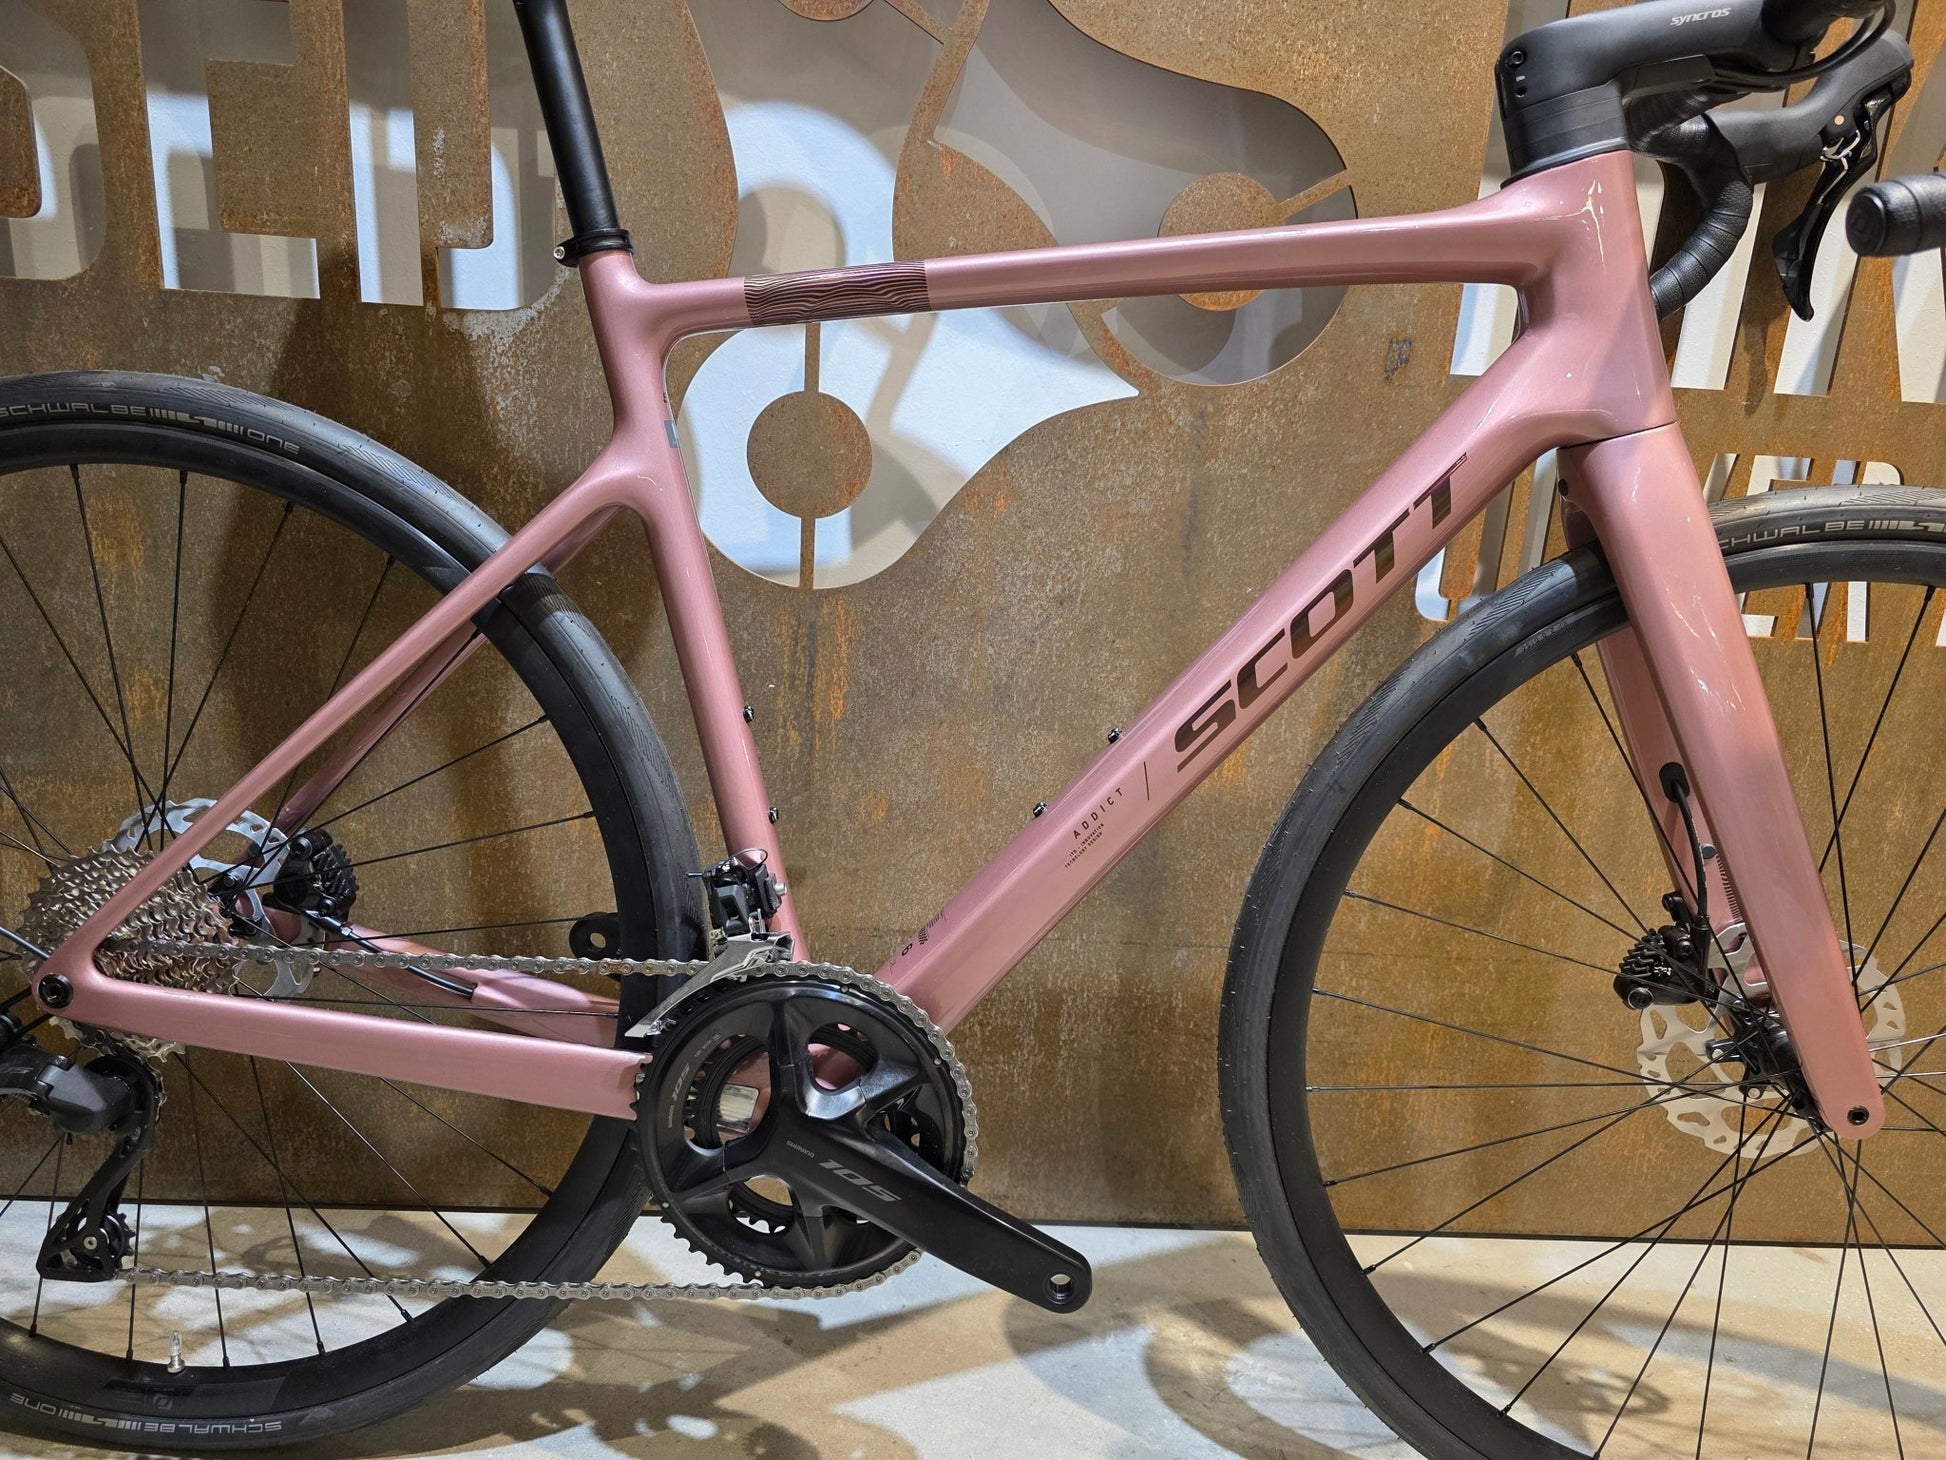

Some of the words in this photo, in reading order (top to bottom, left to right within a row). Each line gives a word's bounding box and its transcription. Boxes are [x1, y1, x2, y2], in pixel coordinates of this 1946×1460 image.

[1669, 7, 1732, 27] syncros
[247, 428, 300, 455] ONE
[1718, 520, 1865, 550] CHWALBE
[1174, 451, 1468, 773] SCOTT
[1073, 787, 1124, 839] ADDICT
[818, 1159, 903, 1202] 105
[144, 1420, 282, 1434] SCHWALBE
